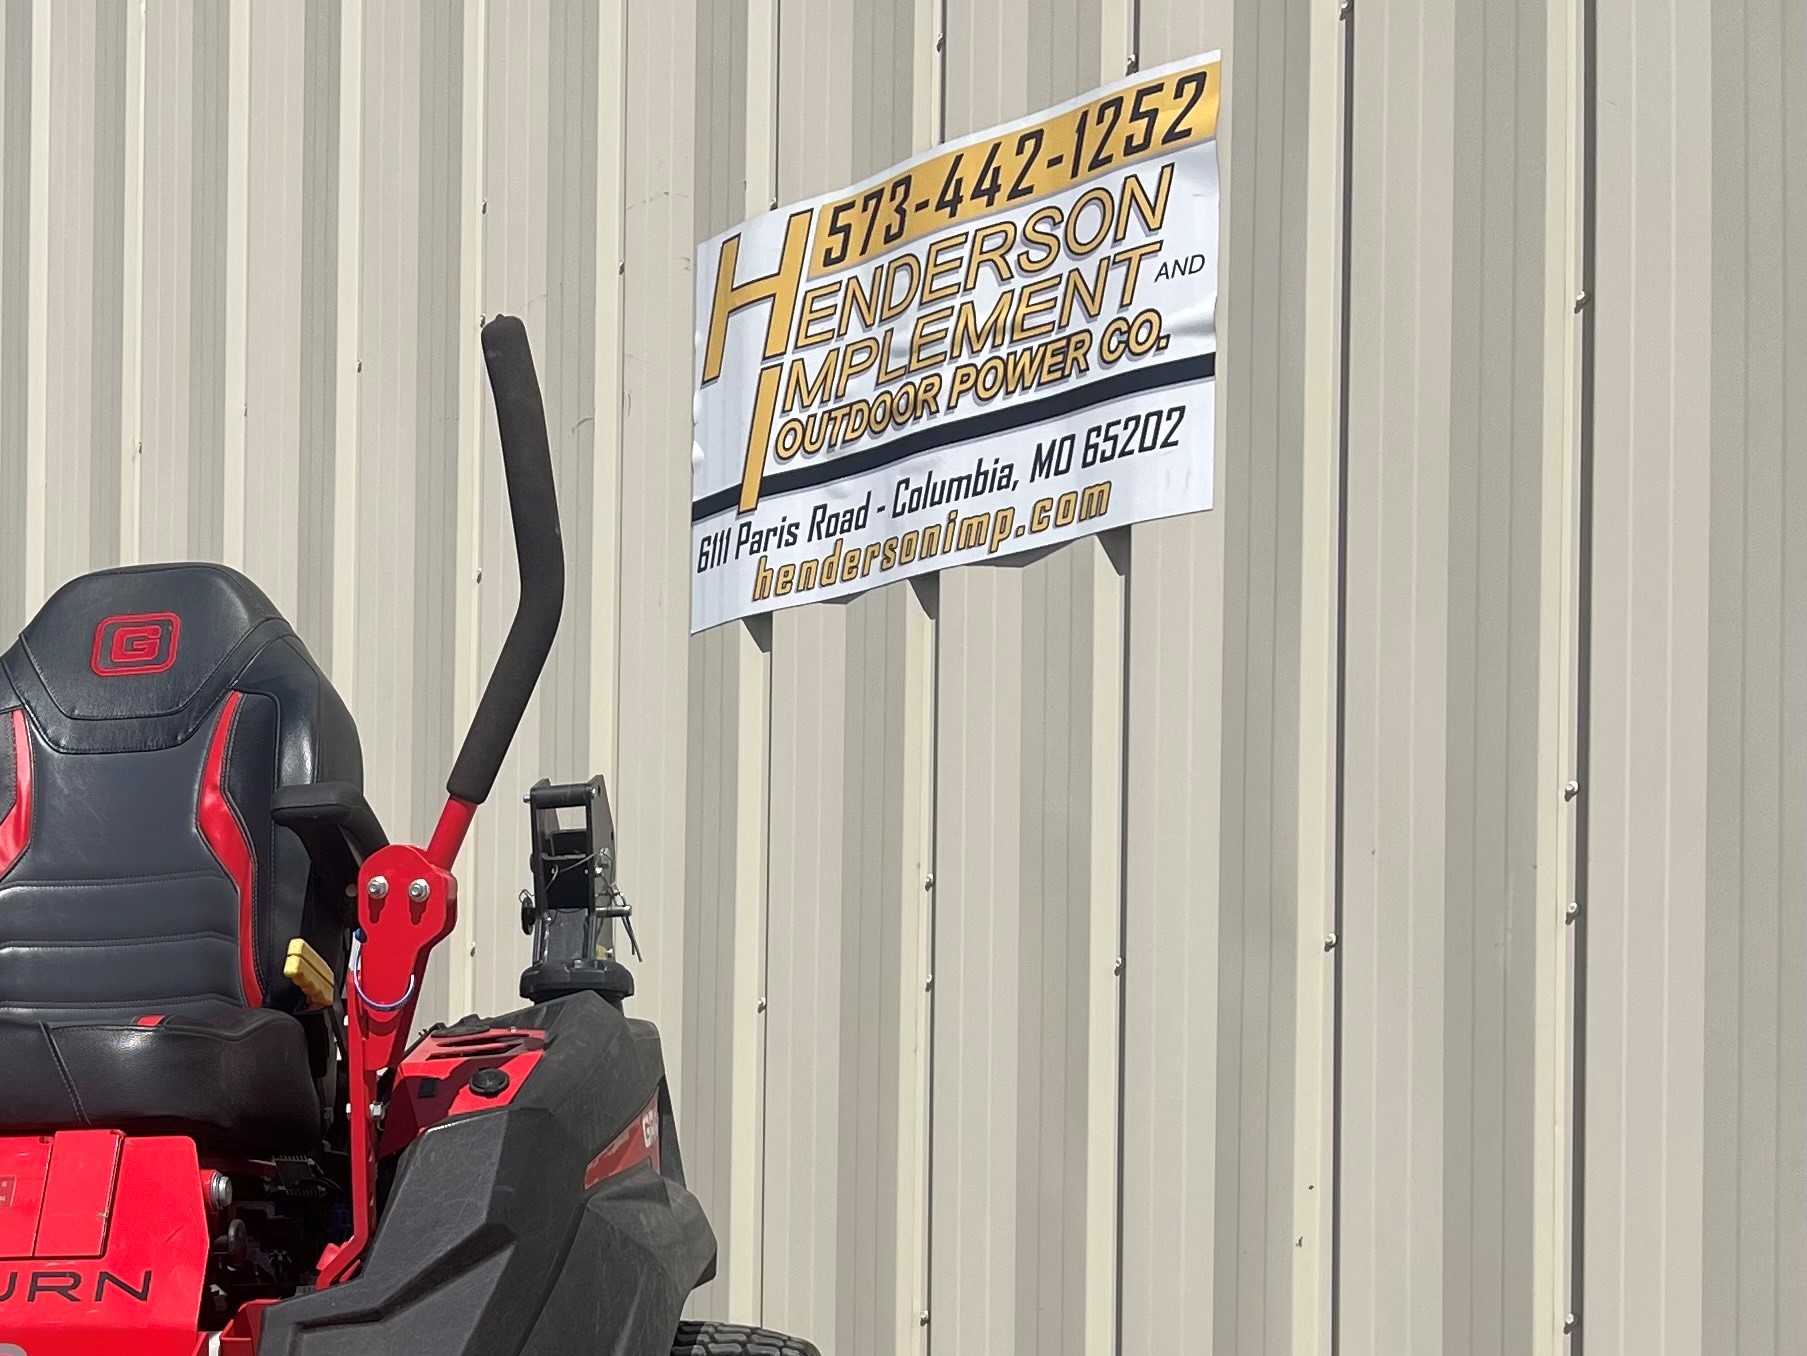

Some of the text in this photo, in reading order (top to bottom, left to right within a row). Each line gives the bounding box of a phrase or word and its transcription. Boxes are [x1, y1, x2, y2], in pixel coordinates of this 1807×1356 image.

[823, 71, 1207, 267] 573-442-1252
[701, 162, 1175, 385] HENDERSON
[737, 240, 1205, 515] IMPLEMENT AND
[775, 308, 1171, 460] OUTDOOR POWER CO.
[697, 527, 732, 573] 6111
[735, 516, 800, 560] Paris
[807, 491, 871, 542] Road
[892, 457, 1019, 519] Columbia,
[1030, 433, 1075, 483] MO
[1081, 405, 1186, 469] 65202
[752, 481, 1112, 601] hendersonimp.com
